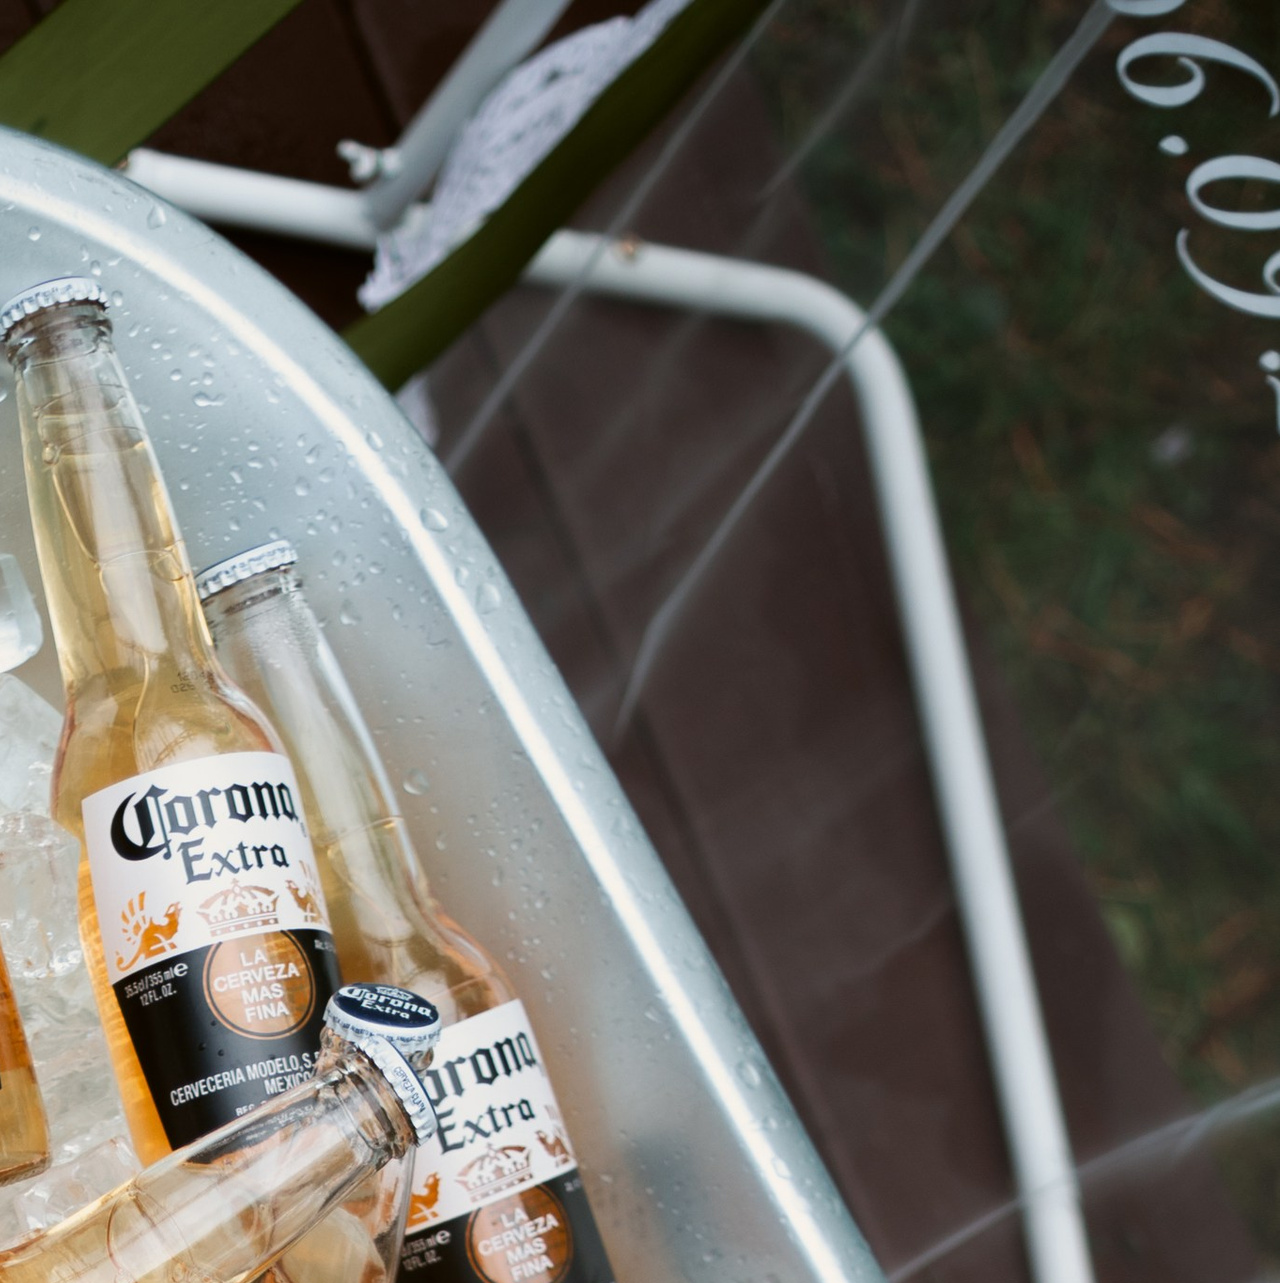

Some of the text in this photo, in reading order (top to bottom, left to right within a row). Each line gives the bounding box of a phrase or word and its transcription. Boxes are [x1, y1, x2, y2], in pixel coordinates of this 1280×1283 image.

[110, 782, 298, 861] Corona
[178, 838, 290, 884] Extra
[240, 948, 267, 966] LA
[214, 962, 300, 992] CERVEZA
[242, 983, 284, 1004] MAS
[246, 1001, 290, 1022] FINA
[170, 1064, 249, 1106] CERVECERIA
[244, 1054, 304, 1081] MODELO,
[420, 1032, 536, 1106] orona
[434, 1099, 535, 1154] Extra
[501, 1207, 528, 1227] LA
[478, 1214, 559, 1257] CERVEZA
[507, 1238, 546, 1264] MAS
[512, 1256, 553, 1281] FINA
